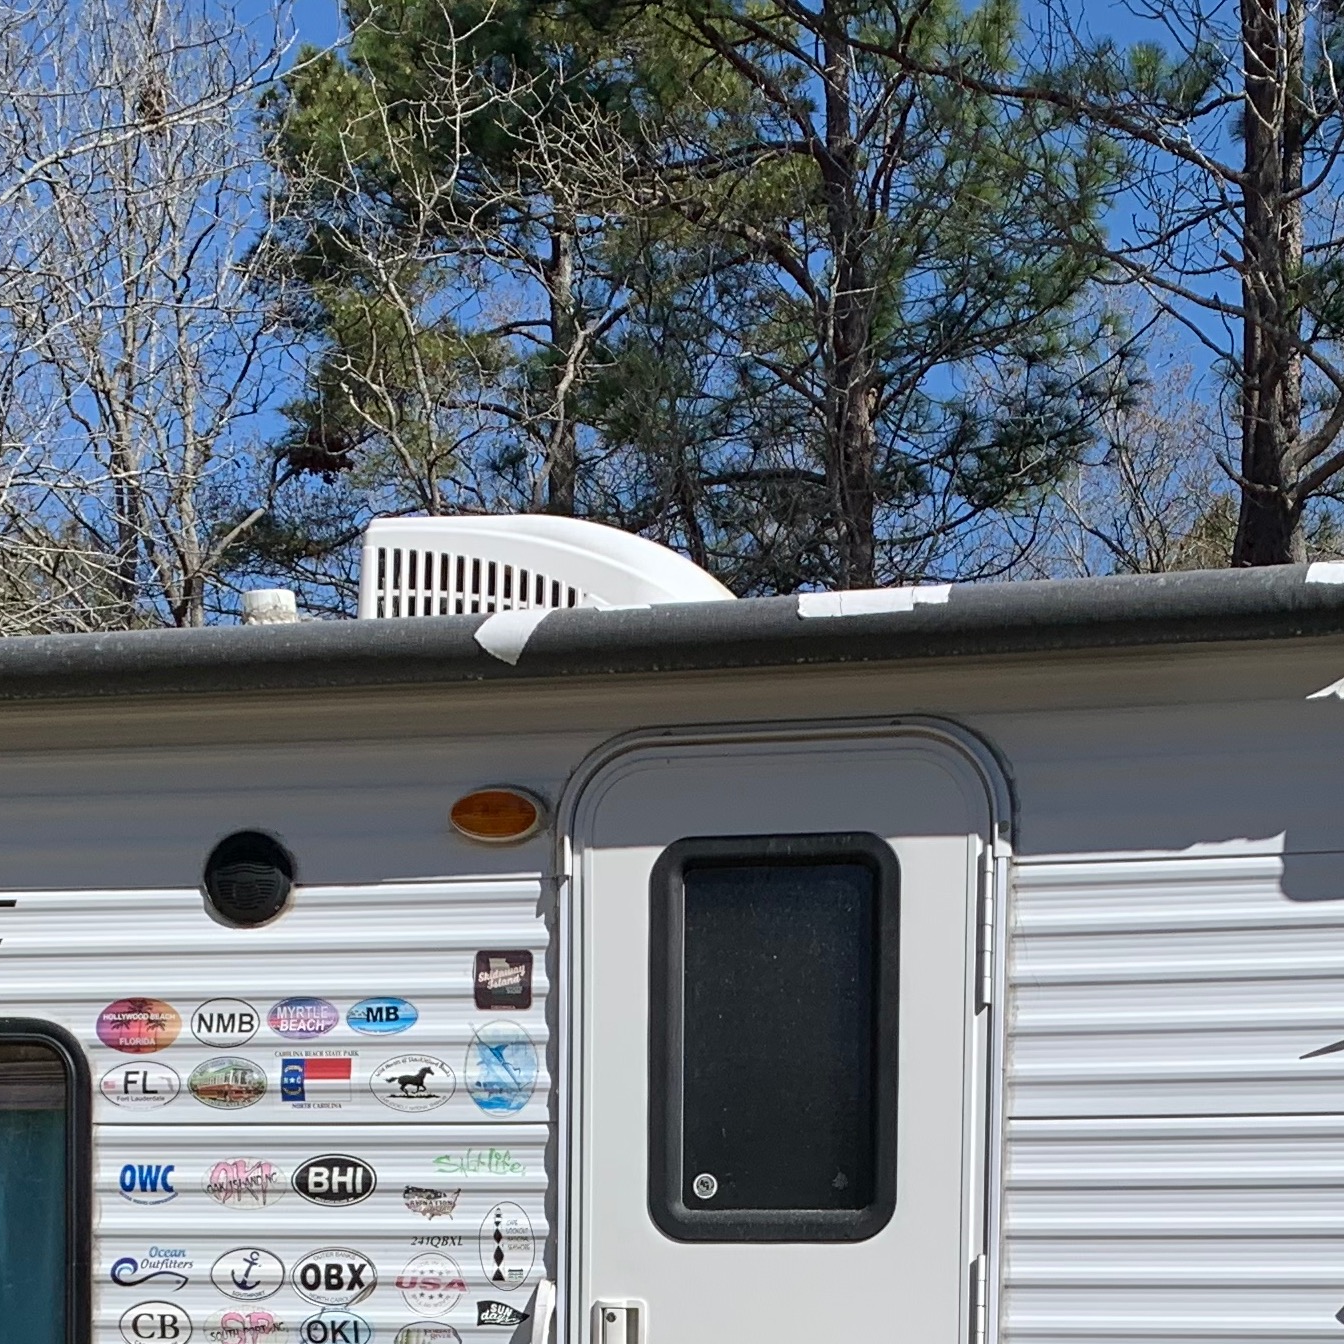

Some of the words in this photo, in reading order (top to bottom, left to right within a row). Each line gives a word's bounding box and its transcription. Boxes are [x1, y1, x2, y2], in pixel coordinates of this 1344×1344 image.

[102, 1012, 149, 1021] HOLLYWOOD
[150, 1013, 176, 1021] BEACH
[276, 1005, 329, 1019] MYRTLE
[366, 1006, 399, 1022] MB
[197, 1013, 254, 1033] NMB
[279, 1019, 325, 1031] BEACH
[119, 1037, 155, 1046] FLORIDA
[123, 1070, 158, 1094] FL
[119, 1164, 175, 1192] OWC
[308, 1166, 363, 1193] BHI
[410, 1235, 463, 1248] 241QBXL
[149, 1246, 186, 1258] Ocean
[313, 1252, 334, 1261] OUTER
[140, 1258, 193, 1270] Outfitters
[300, 1263, 367, 1291] OBX
[395, 1275, 467, 1292] USA
[490, 1303, 513, 1317] SUN
[131, 1312, 180, 1339] CB
[306, 1319, 361, 1344] OKI
